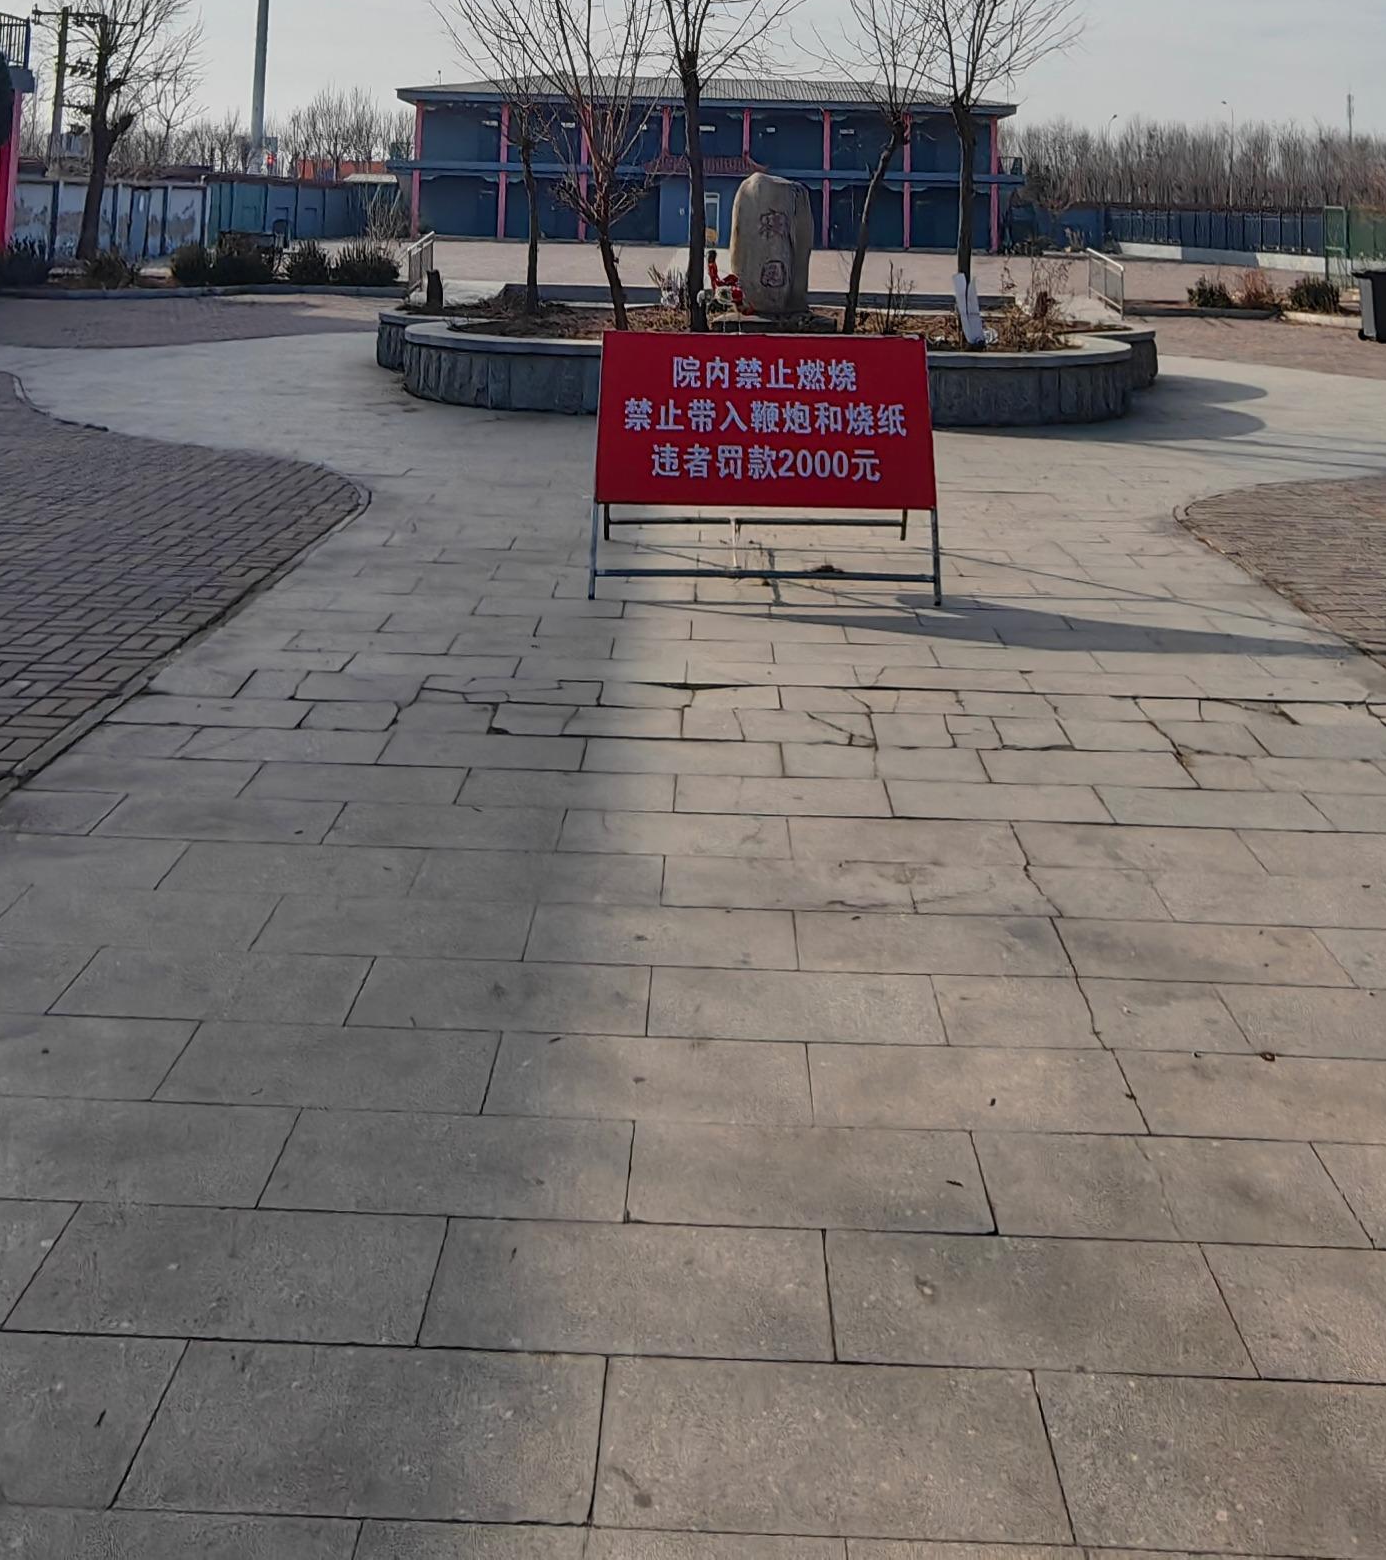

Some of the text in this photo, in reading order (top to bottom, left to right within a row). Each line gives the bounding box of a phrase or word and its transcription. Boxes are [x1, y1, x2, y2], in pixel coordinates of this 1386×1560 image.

[673, 356, 856, 391] 院内禁止燃烧
[624, 398, 906, 435] 禁止带入鞭炮和烧纸
[651, 443, 880, 480] 违者罚款2000元
